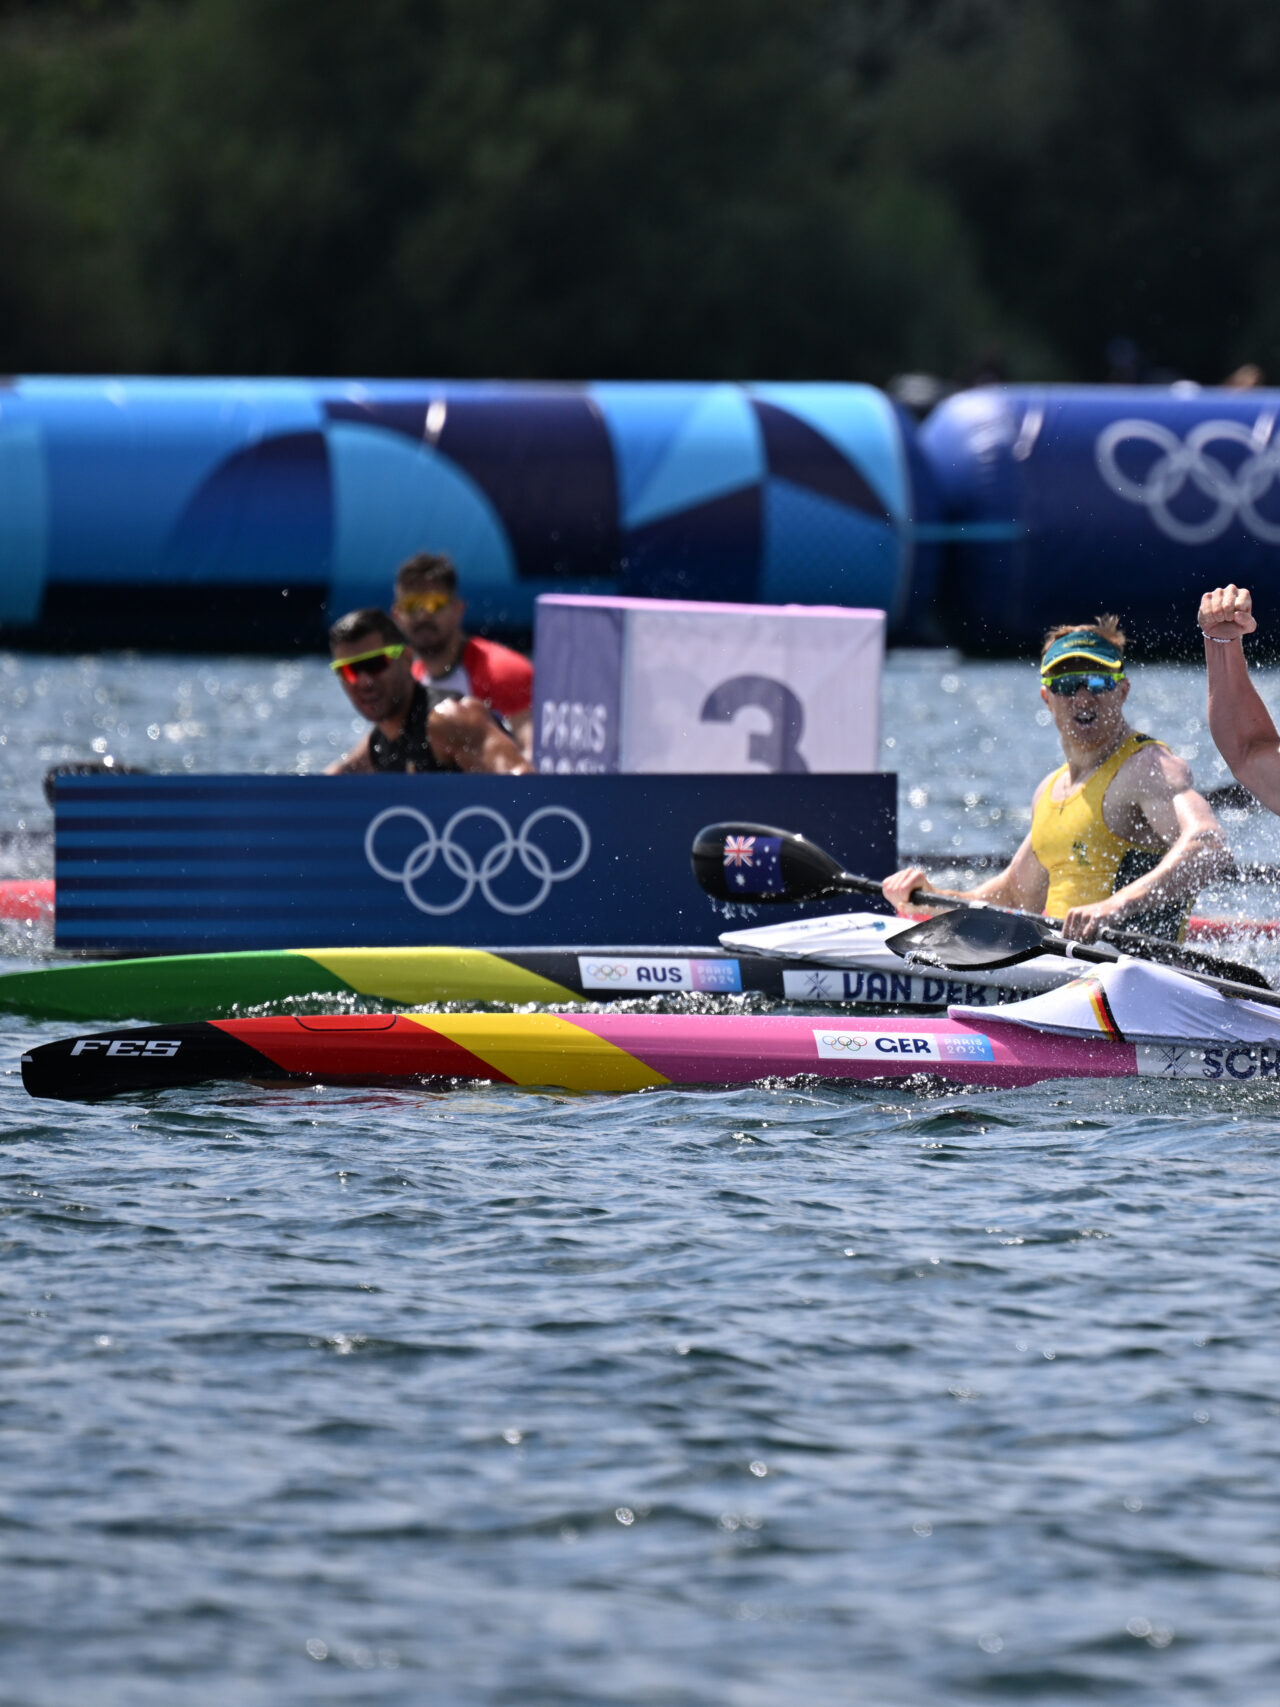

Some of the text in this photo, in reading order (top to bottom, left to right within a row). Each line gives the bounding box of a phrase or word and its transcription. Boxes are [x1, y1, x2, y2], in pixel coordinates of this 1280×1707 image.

[540, 701, 607, 752] PARIS
[700, 674, 810, 773] 3
[636, 965, 683, 984] AUS
[843, 973, 911, 1001] VAN
[70, 1040, 182, 1057] FES
[875, 1037, 931, 1055] GER
[943, 1038, 983, 1047] PARIS
[946, 1045, 985, 1055] 2024
